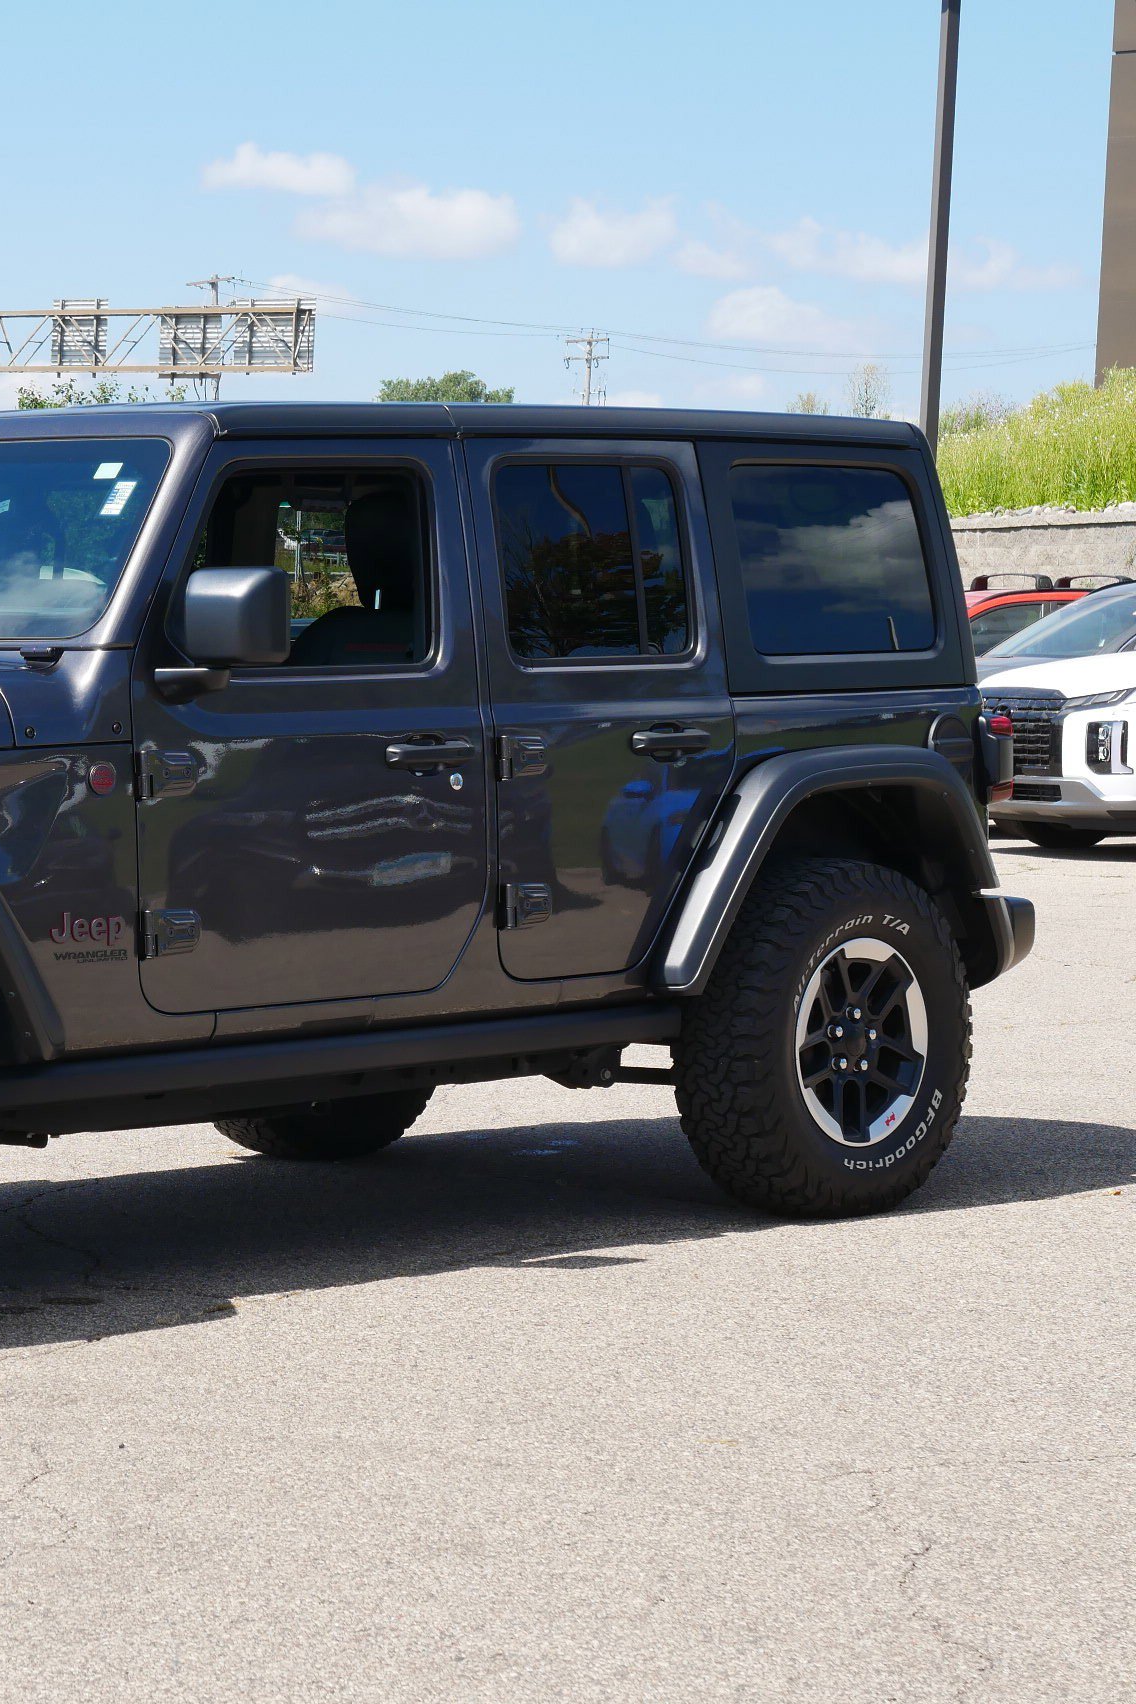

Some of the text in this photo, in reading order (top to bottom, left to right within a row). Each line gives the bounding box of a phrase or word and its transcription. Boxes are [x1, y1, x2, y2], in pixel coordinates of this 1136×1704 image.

[50, 911, 127, 946] Jeep
[882, 914, 911, 936] T/A
[53, 949, 127, 961] WRANGLER
[843, 1088, 943, 1171] BFGoodrich
